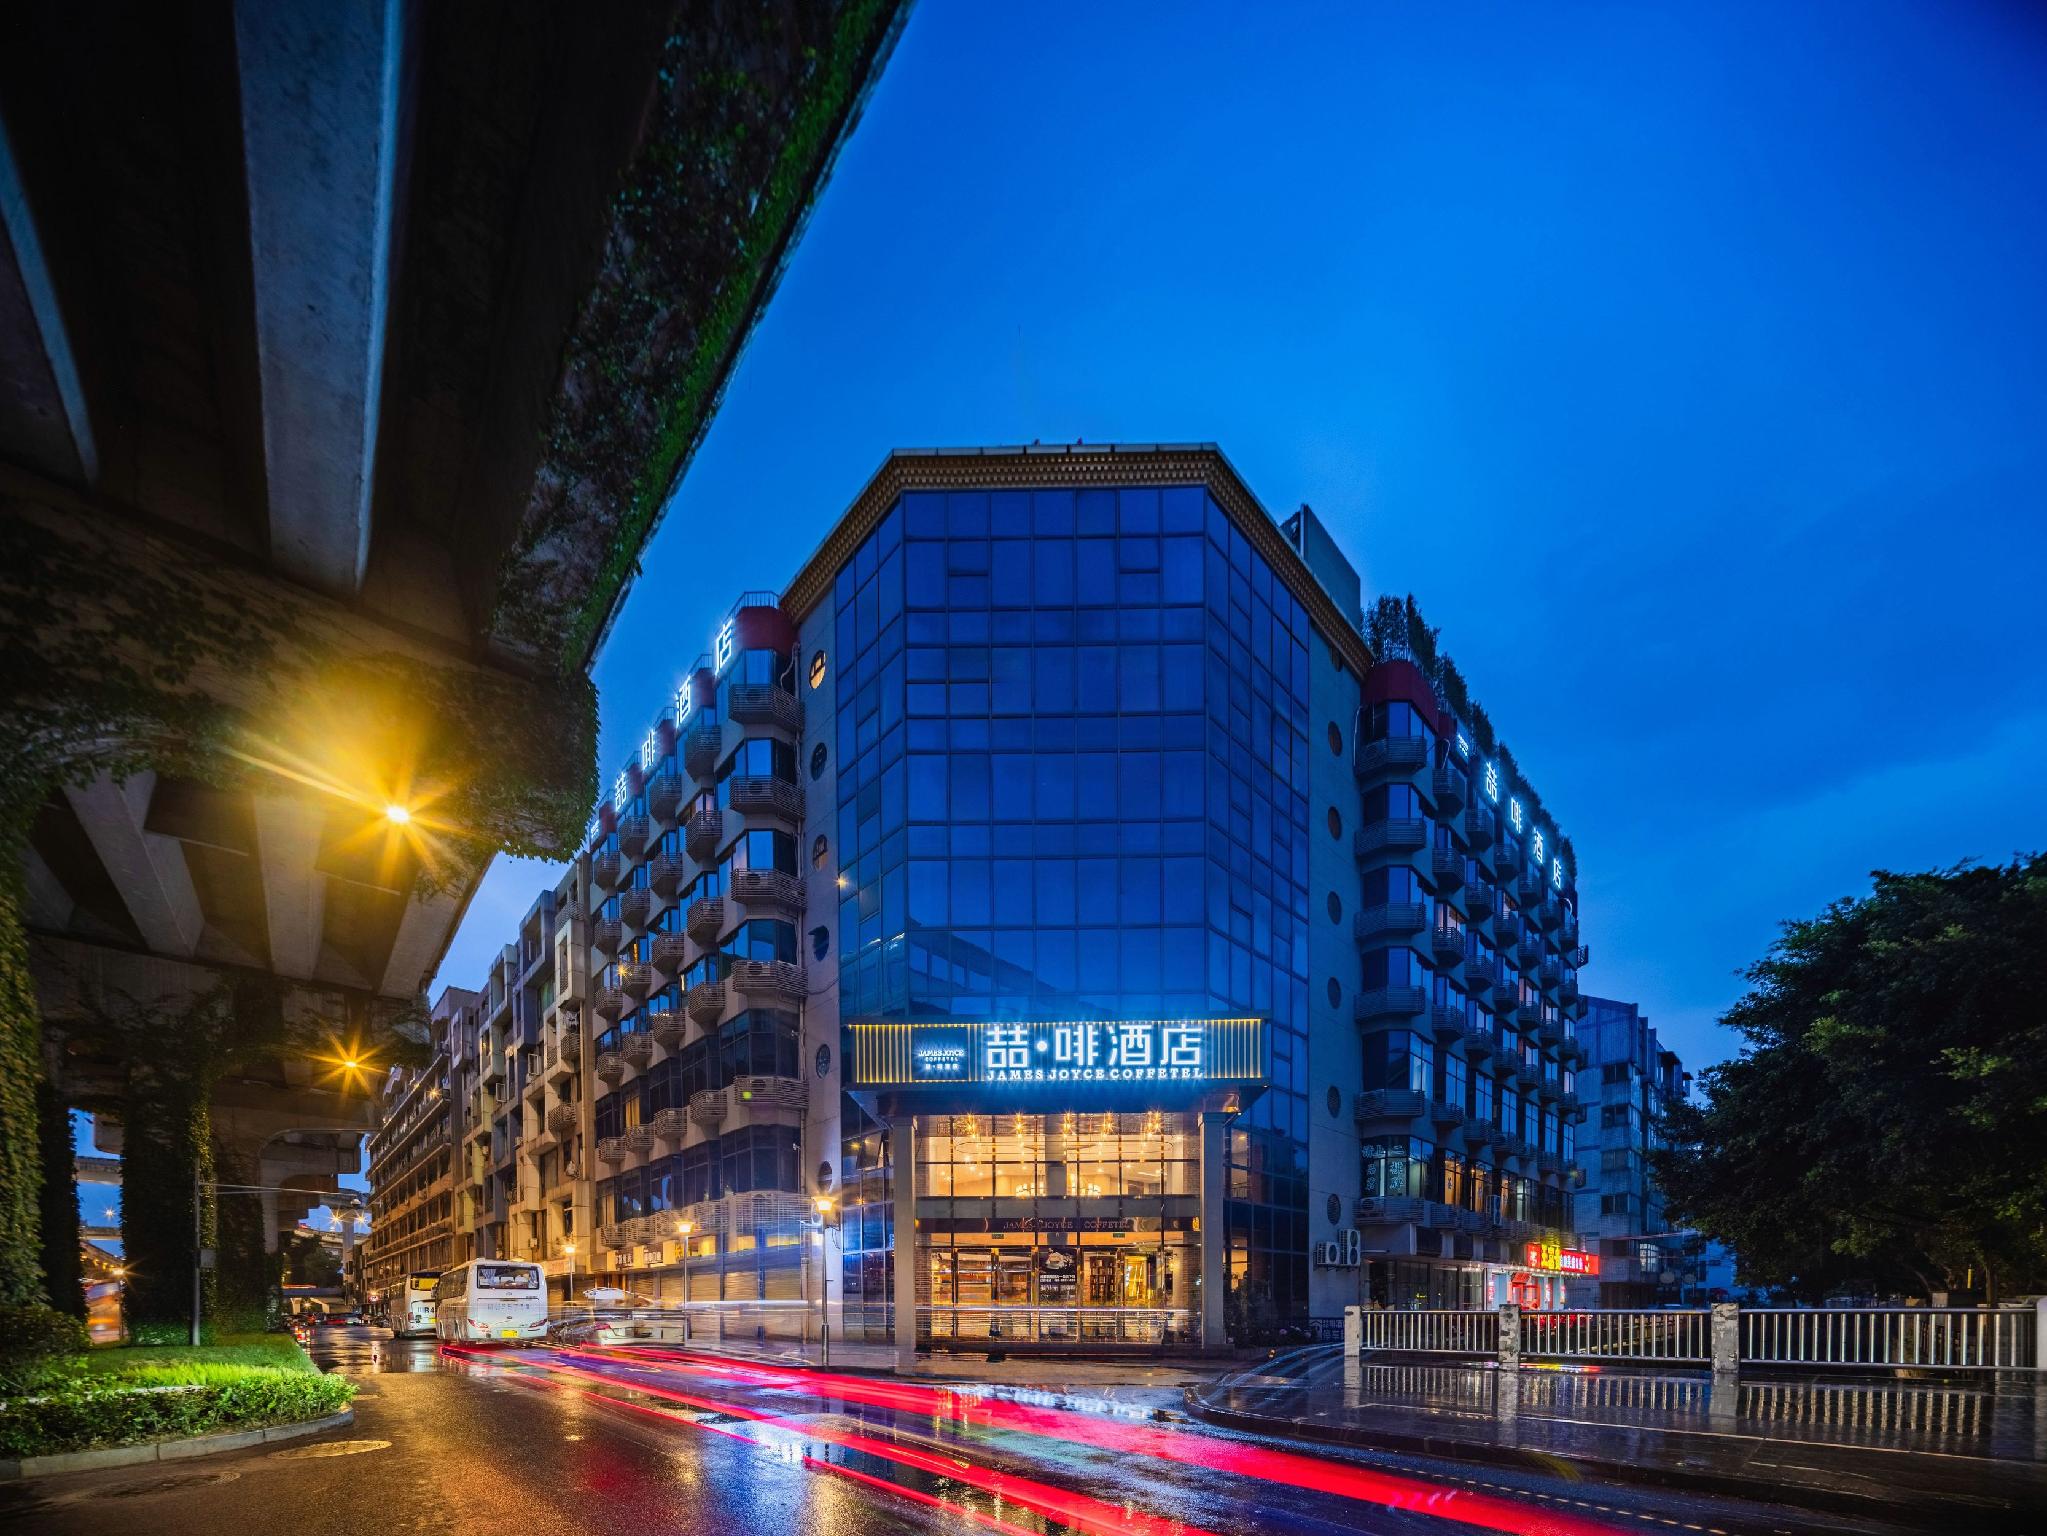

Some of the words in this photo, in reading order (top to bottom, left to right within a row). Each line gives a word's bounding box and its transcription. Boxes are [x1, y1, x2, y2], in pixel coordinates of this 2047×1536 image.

[919, 1049, 942, 1057] JAMES
[987, 1069, 1044, 1081] JAMES
[1049, 1068, 1105, 1080] JOYCE
[1109, 1067, 1204, 1079] COFFETEL
